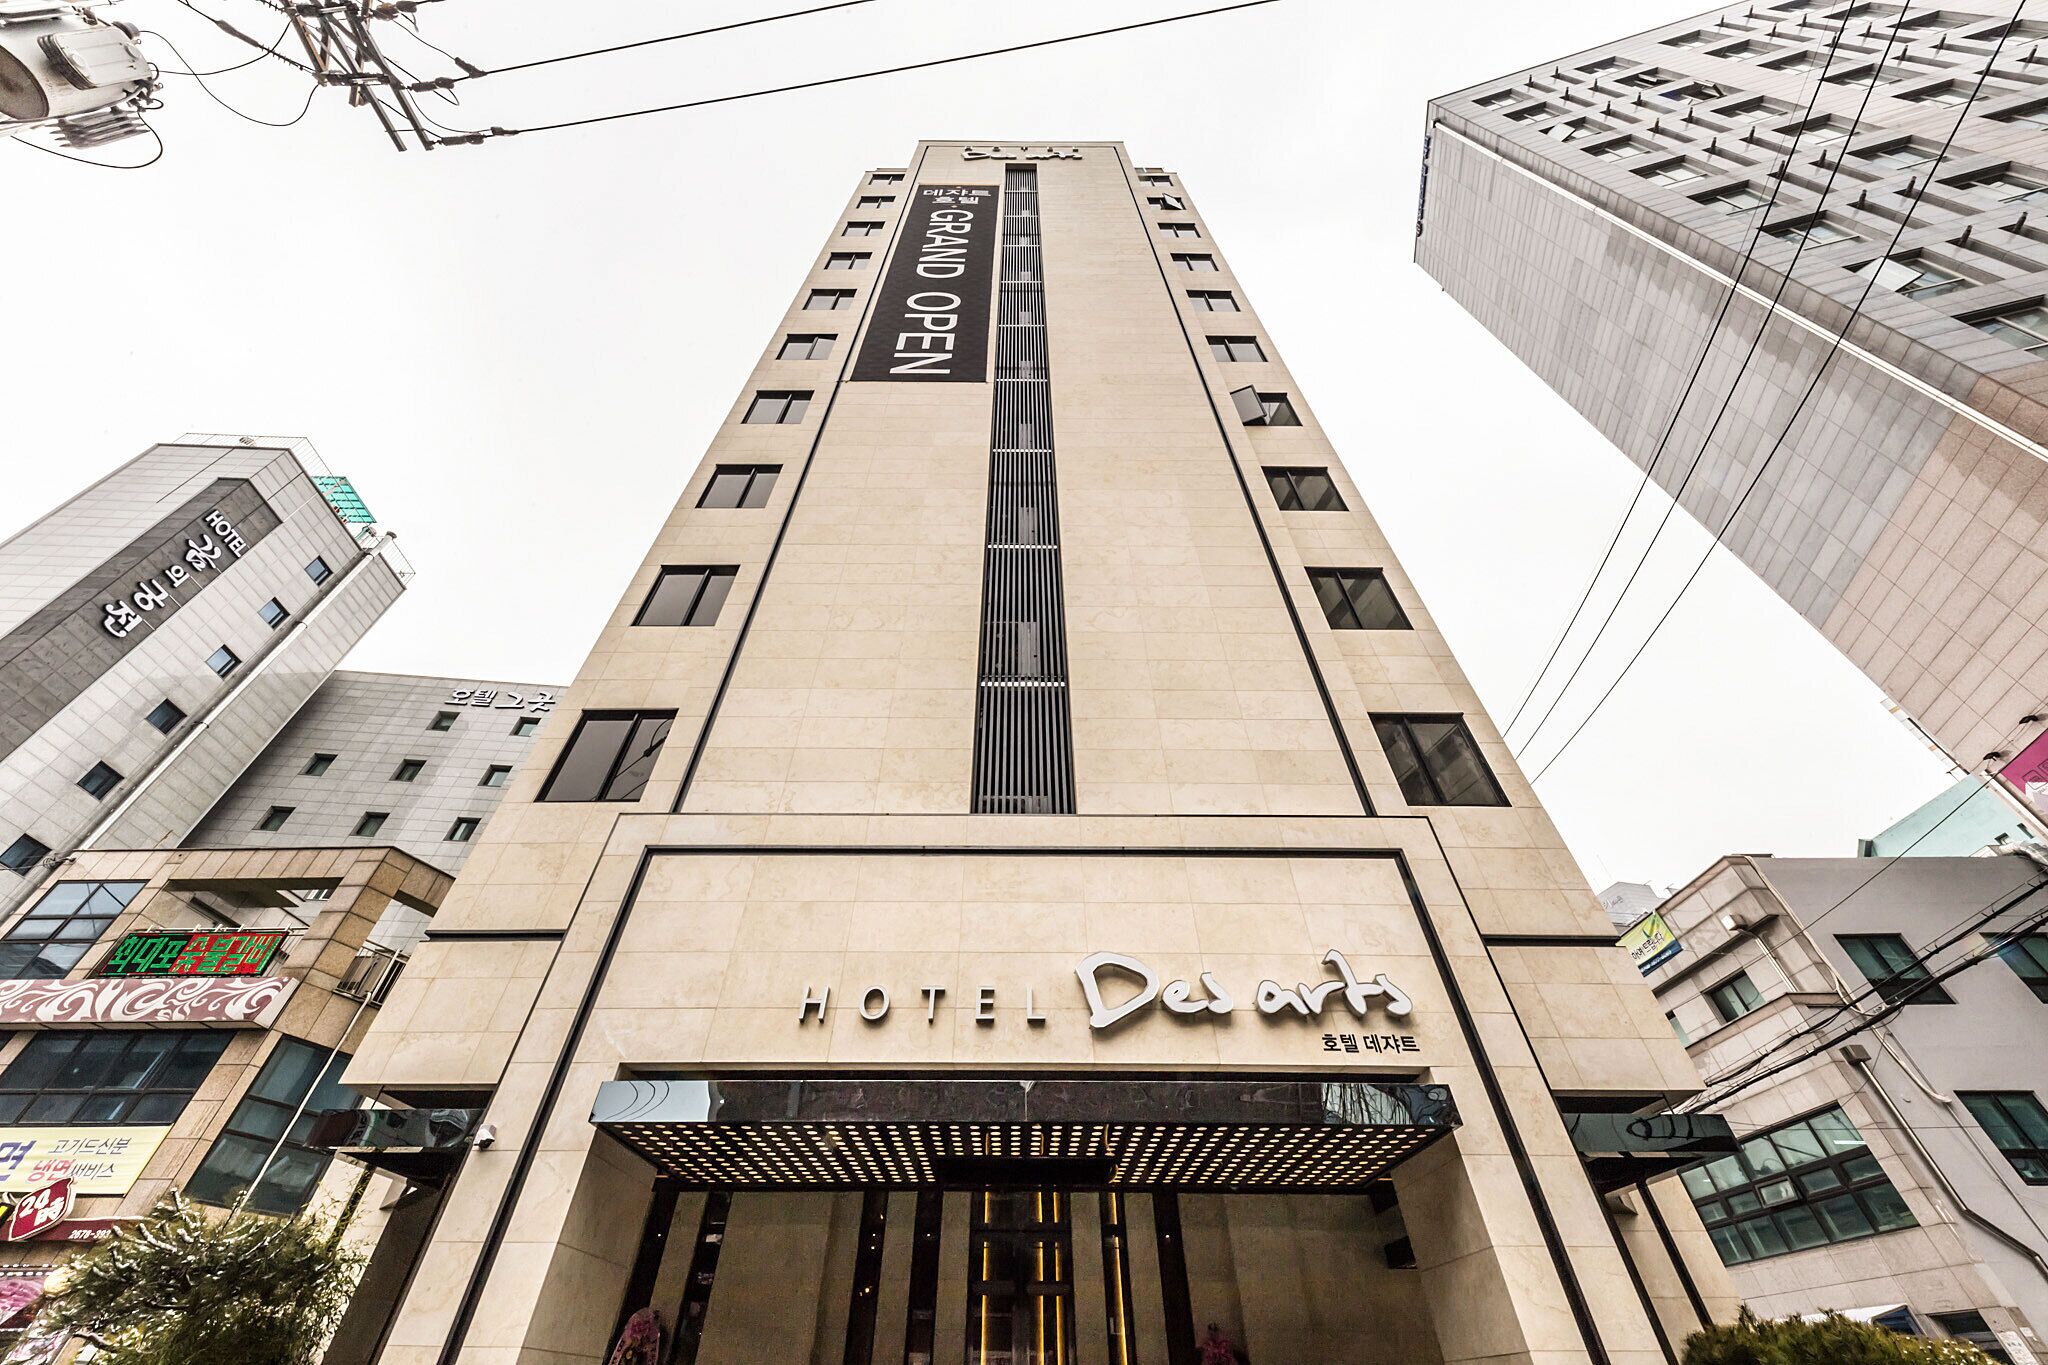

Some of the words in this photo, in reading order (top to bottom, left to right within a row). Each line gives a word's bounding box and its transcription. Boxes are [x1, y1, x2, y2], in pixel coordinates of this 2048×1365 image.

[932, 196, 979, 205] 호텔
[916, 209, 974, 279] GRAND
[889, 291, 961, 375] OPEN
[204, 509, 247, 559] HOTEL
[444, 687, 498, 707] 호텔
[798, 985, 1046, 1024] HOTEL
[1075, 951, 1234, 1029] Des
[1256, 949, 1414, 1017] arts
[1321, 1033, 1360, 1053] 호텔
[1362, 1033, 1421, 1054] 데쟈트
